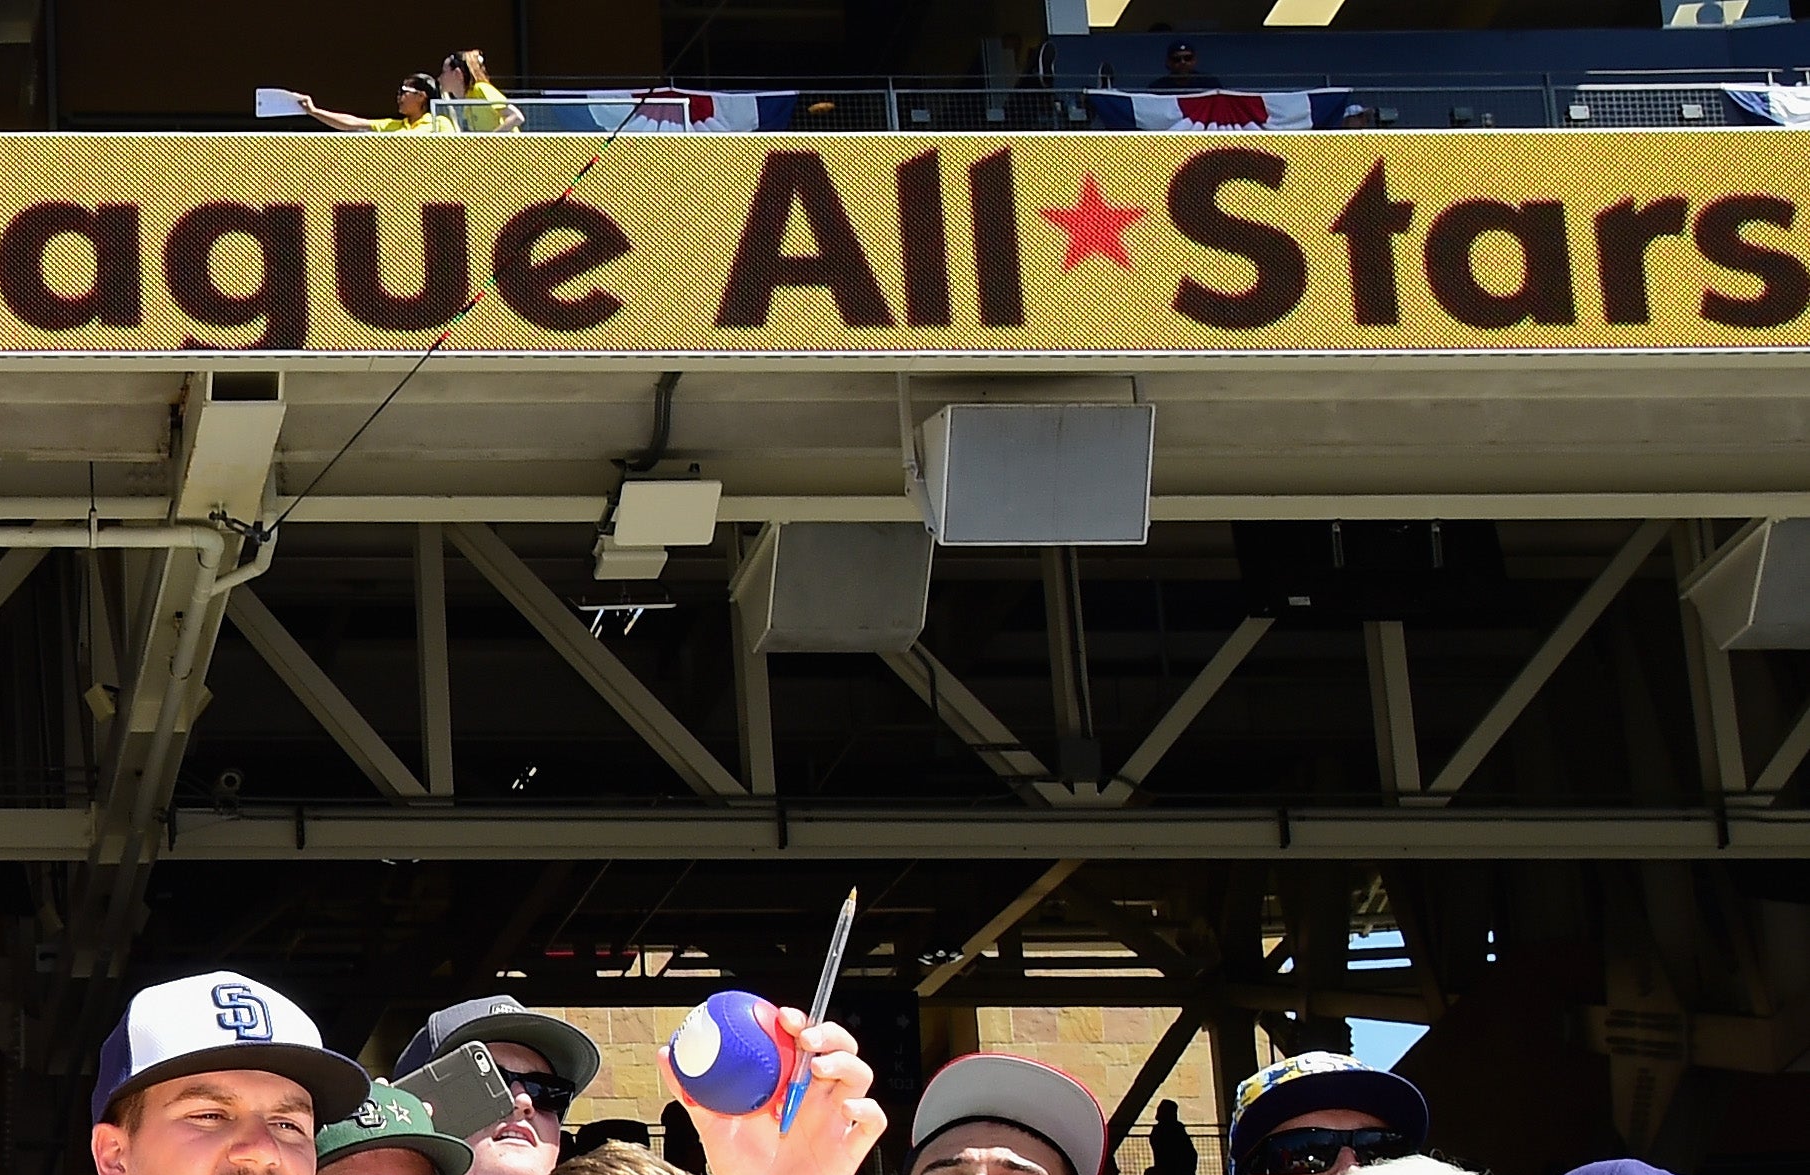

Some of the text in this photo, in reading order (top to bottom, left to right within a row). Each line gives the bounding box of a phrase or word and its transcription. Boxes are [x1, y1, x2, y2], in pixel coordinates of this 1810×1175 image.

[716, 146, 1025, 329] All
[1167, 148, 1810, 332] Stars
[211, 983, 273, 1042] SD
